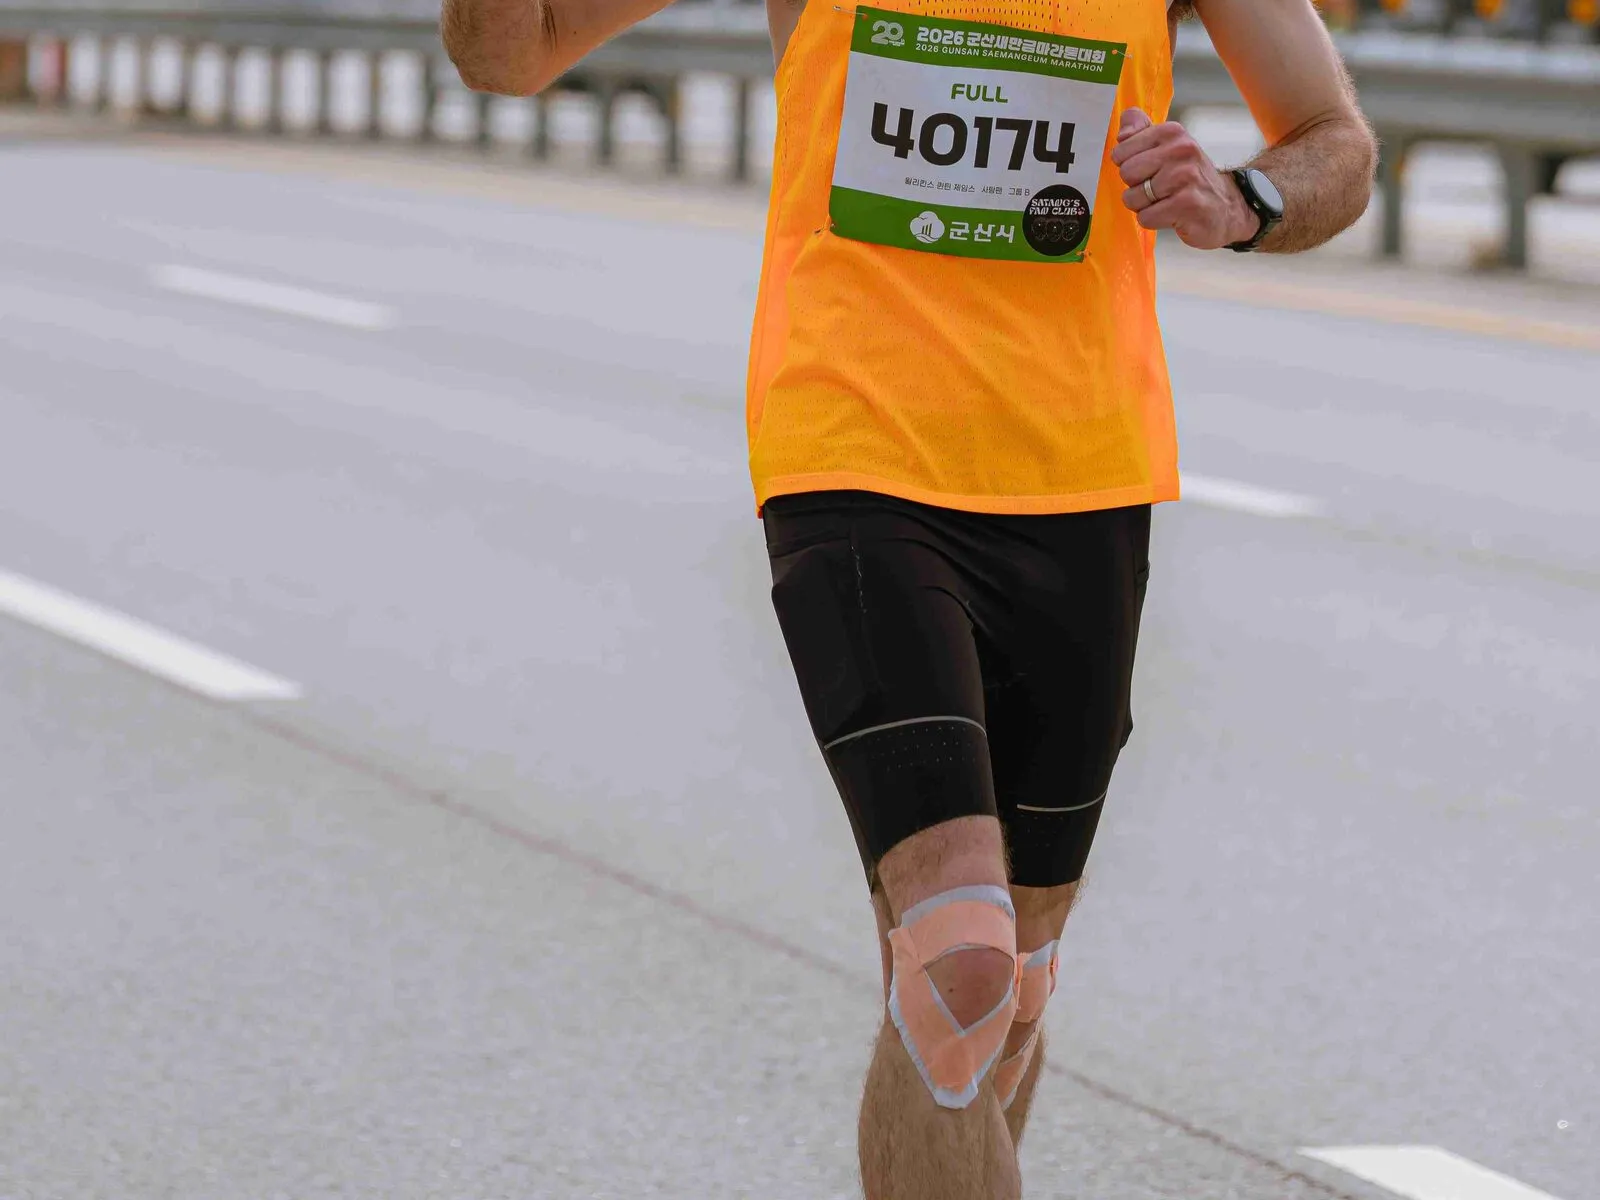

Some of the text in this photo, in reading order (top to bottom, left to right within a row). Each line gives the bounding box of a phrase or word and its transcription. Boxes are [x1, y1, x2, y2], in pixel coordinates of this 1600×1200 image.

[917, 26, 1106, 64] 2026 군산새만금마라톤대회
[915, 43, 939, 53] 2026
[942, 46, 980, 57] GUNSAN
[982, 49, 1048, 64] SAEMANGEUM
[1050, 59, 1103, 72] MARATHON
[950, 83, 1009, 104] FULL
[870, 102, 1076, 174] 40174
[1024, 188, 1031, 197] B
[1031, 198, 1081, 207] SATANG'S
[1029, 207, 1078, 216] FAN CLUB
[949, 221, 1015, 244] 군산시
